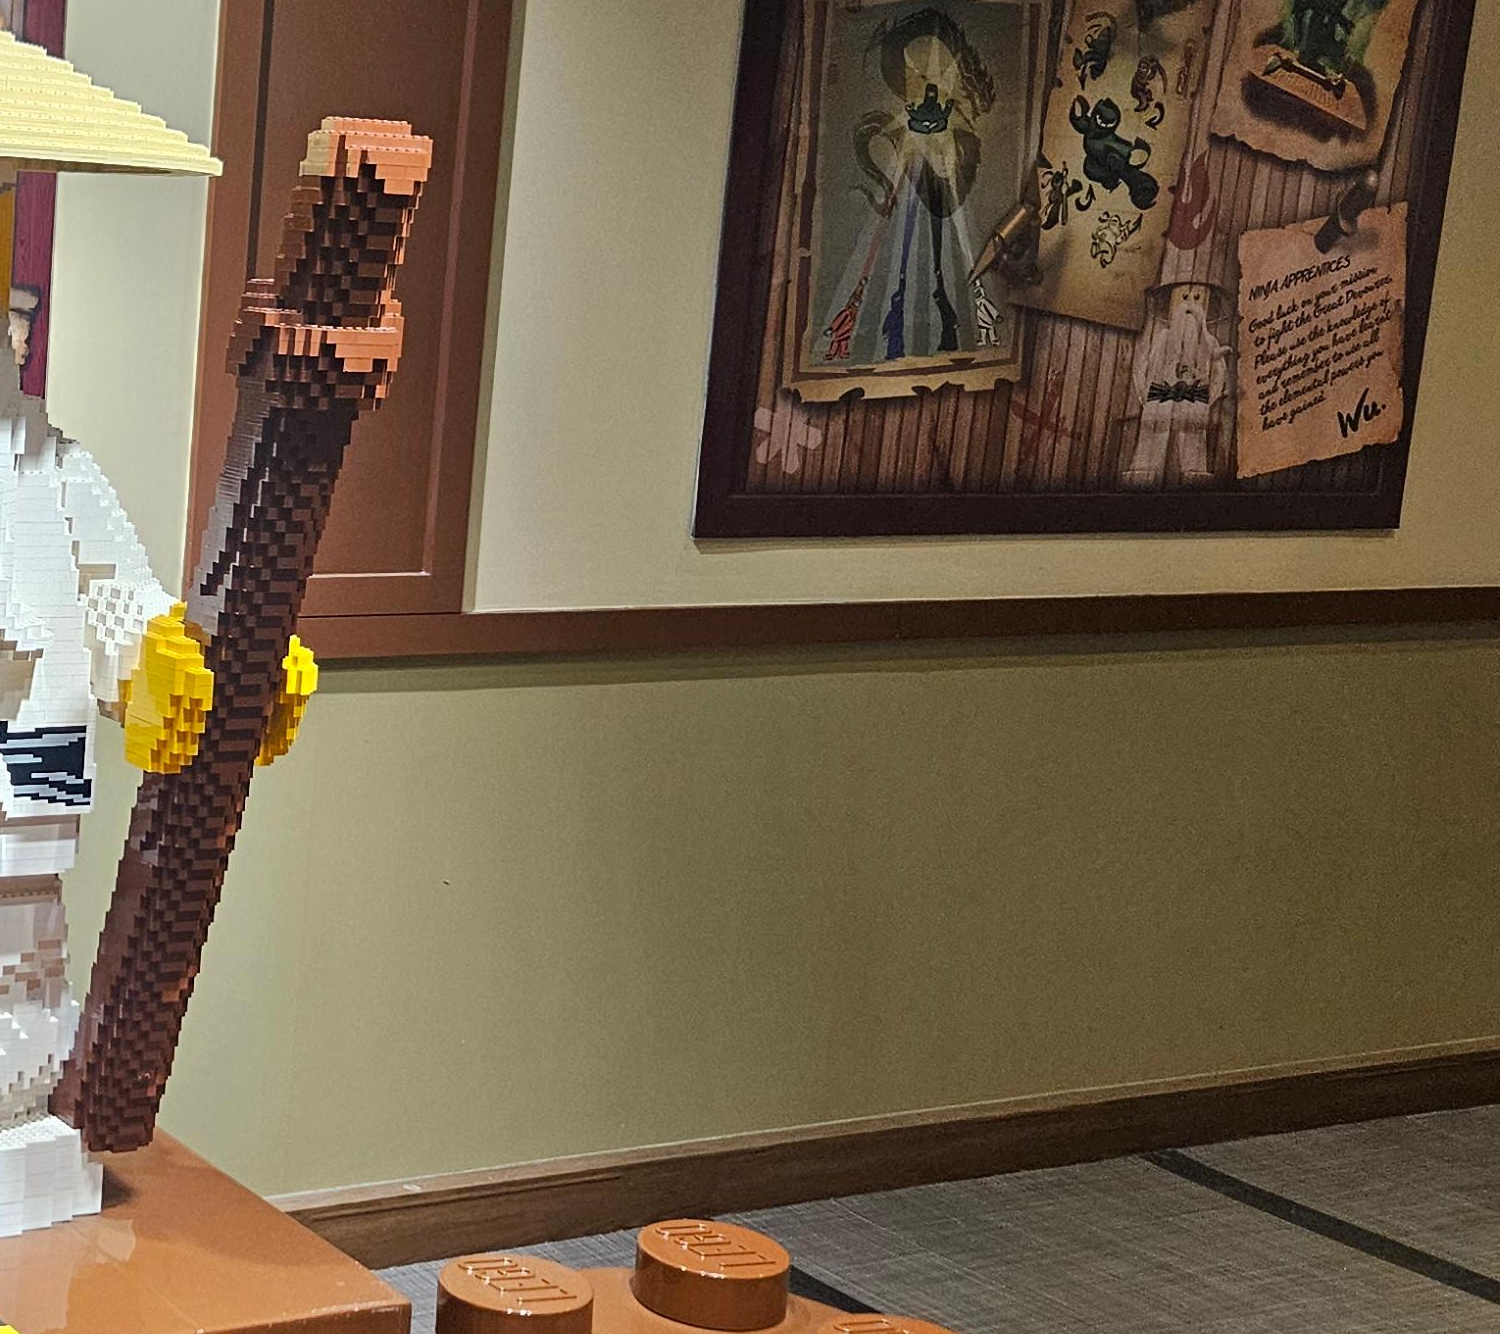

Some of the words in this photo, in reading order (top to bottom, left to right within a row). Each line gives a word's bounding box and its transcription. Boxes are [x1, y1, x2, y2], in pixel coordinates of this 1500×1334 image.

[1249, 279, 1278, 301] NINJA
[1281, 255, 1351, 289] APPRENTICES
[1249, 310, 1273, 333] Good
[1276, 299, 1298, 320] luck
[1301, 298, 1312, 308] on
[1315, 286, 1338, 307] your
[1340, 266, 1378, 288] mission
[1254, 334, 1265, 347] to
[1267, 317, 1294, 349] fight
[1295, 312, 1312, 328] the
[1314, 295, 1344, 317] Great
[1255, 347, 1288, 370] Please
[1290, 337, 1306, 351] use
[1307, 326, 1324, 342] the
[1327, 301, 1378, 332] knowledge
[1379, 290, 1390, 313] of
[1256, 354, 1308, 385] everything
[1312, 344, 1329, 361] you
[1332, 328, 1357, 347] have
[1259, 384, 1278, 400] and
[1281, 359, 1331, 388] remember
[1332, 351, 1343, 364] to
[1345, 343, 1362, 357] use
[1362, 328, 1380, 348] all
[1260, 398, 1277, 415] the
[1279, 369, 1329, 406] elemental
[1330, 357, 1364, 386] powers
[1366, 350, 1384, 368] you
[1262, 412, 1288, 430] have
[456, 1256, 578, 1304] LEGO
